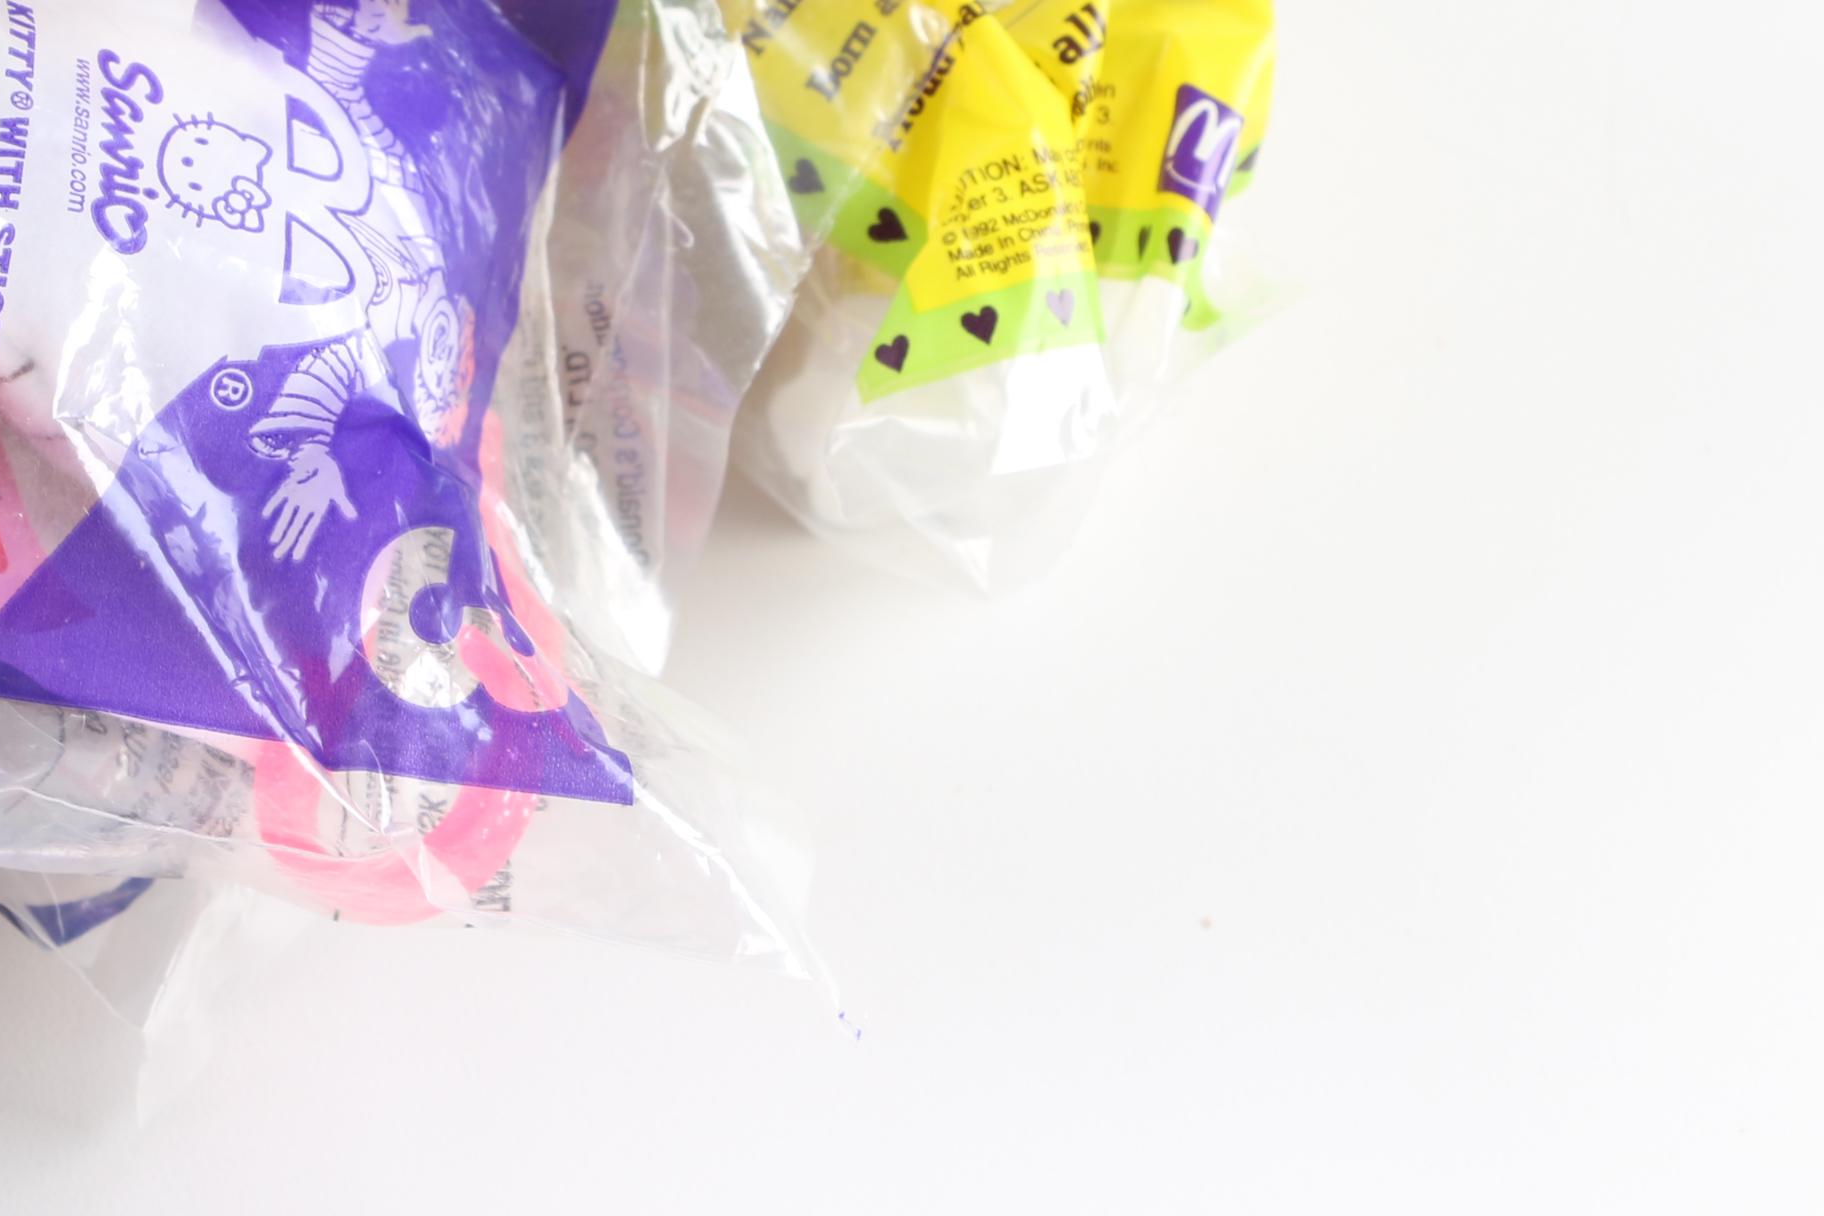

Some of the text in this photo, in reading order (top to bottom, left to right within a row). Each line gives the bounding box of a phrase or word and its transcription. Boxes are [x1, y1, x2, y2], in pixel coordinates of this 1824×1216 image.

[66, 56, 92, 215] www.sanrio.com
[89, 47, 166, 257] Sanrio
[980, 249, 1033, 274] Rights
